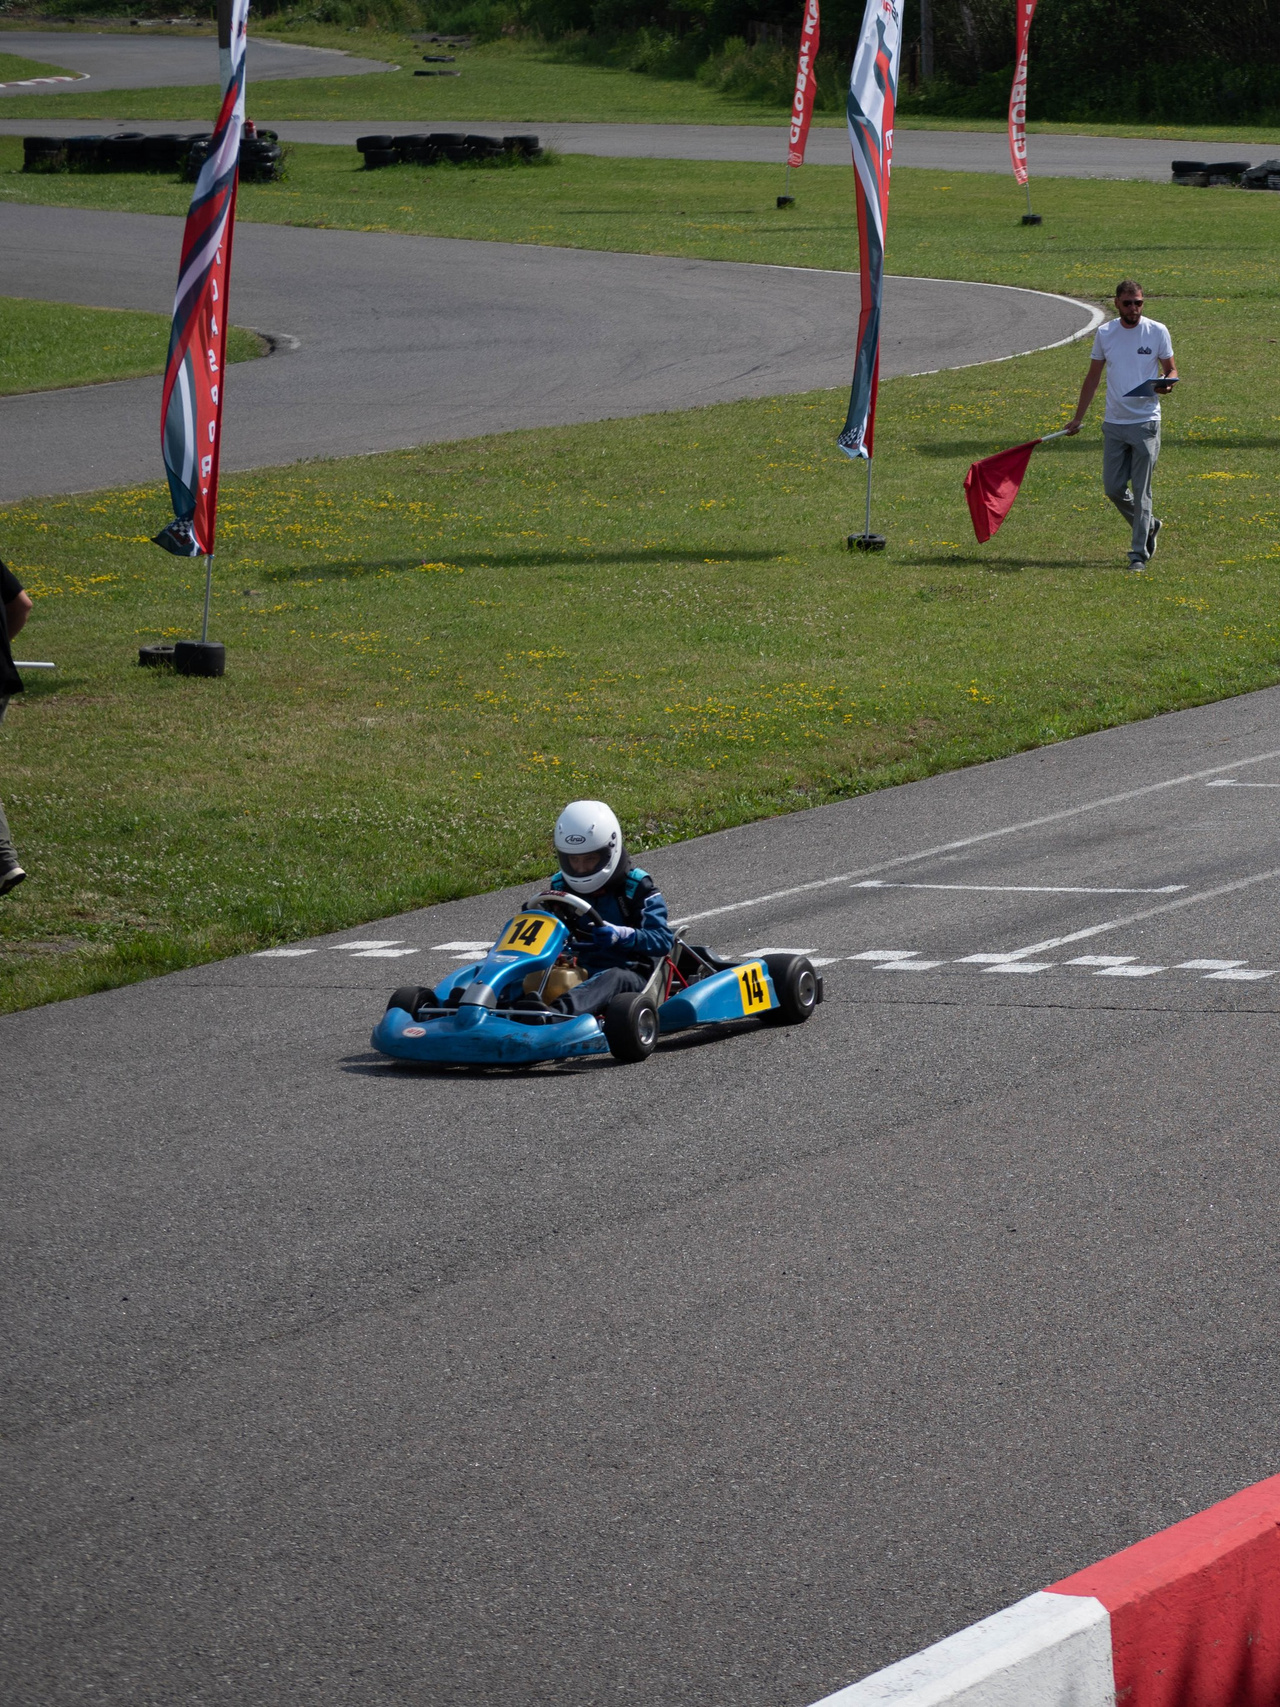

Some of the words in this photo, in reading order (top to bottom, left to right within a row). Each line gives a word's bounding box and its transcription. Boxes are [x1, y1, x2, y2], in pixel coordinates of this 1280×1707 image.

[566, 835, 585, 844] Arai
[507, 918, 545, 946] 14
[742, 968, 763, 1006] 14
